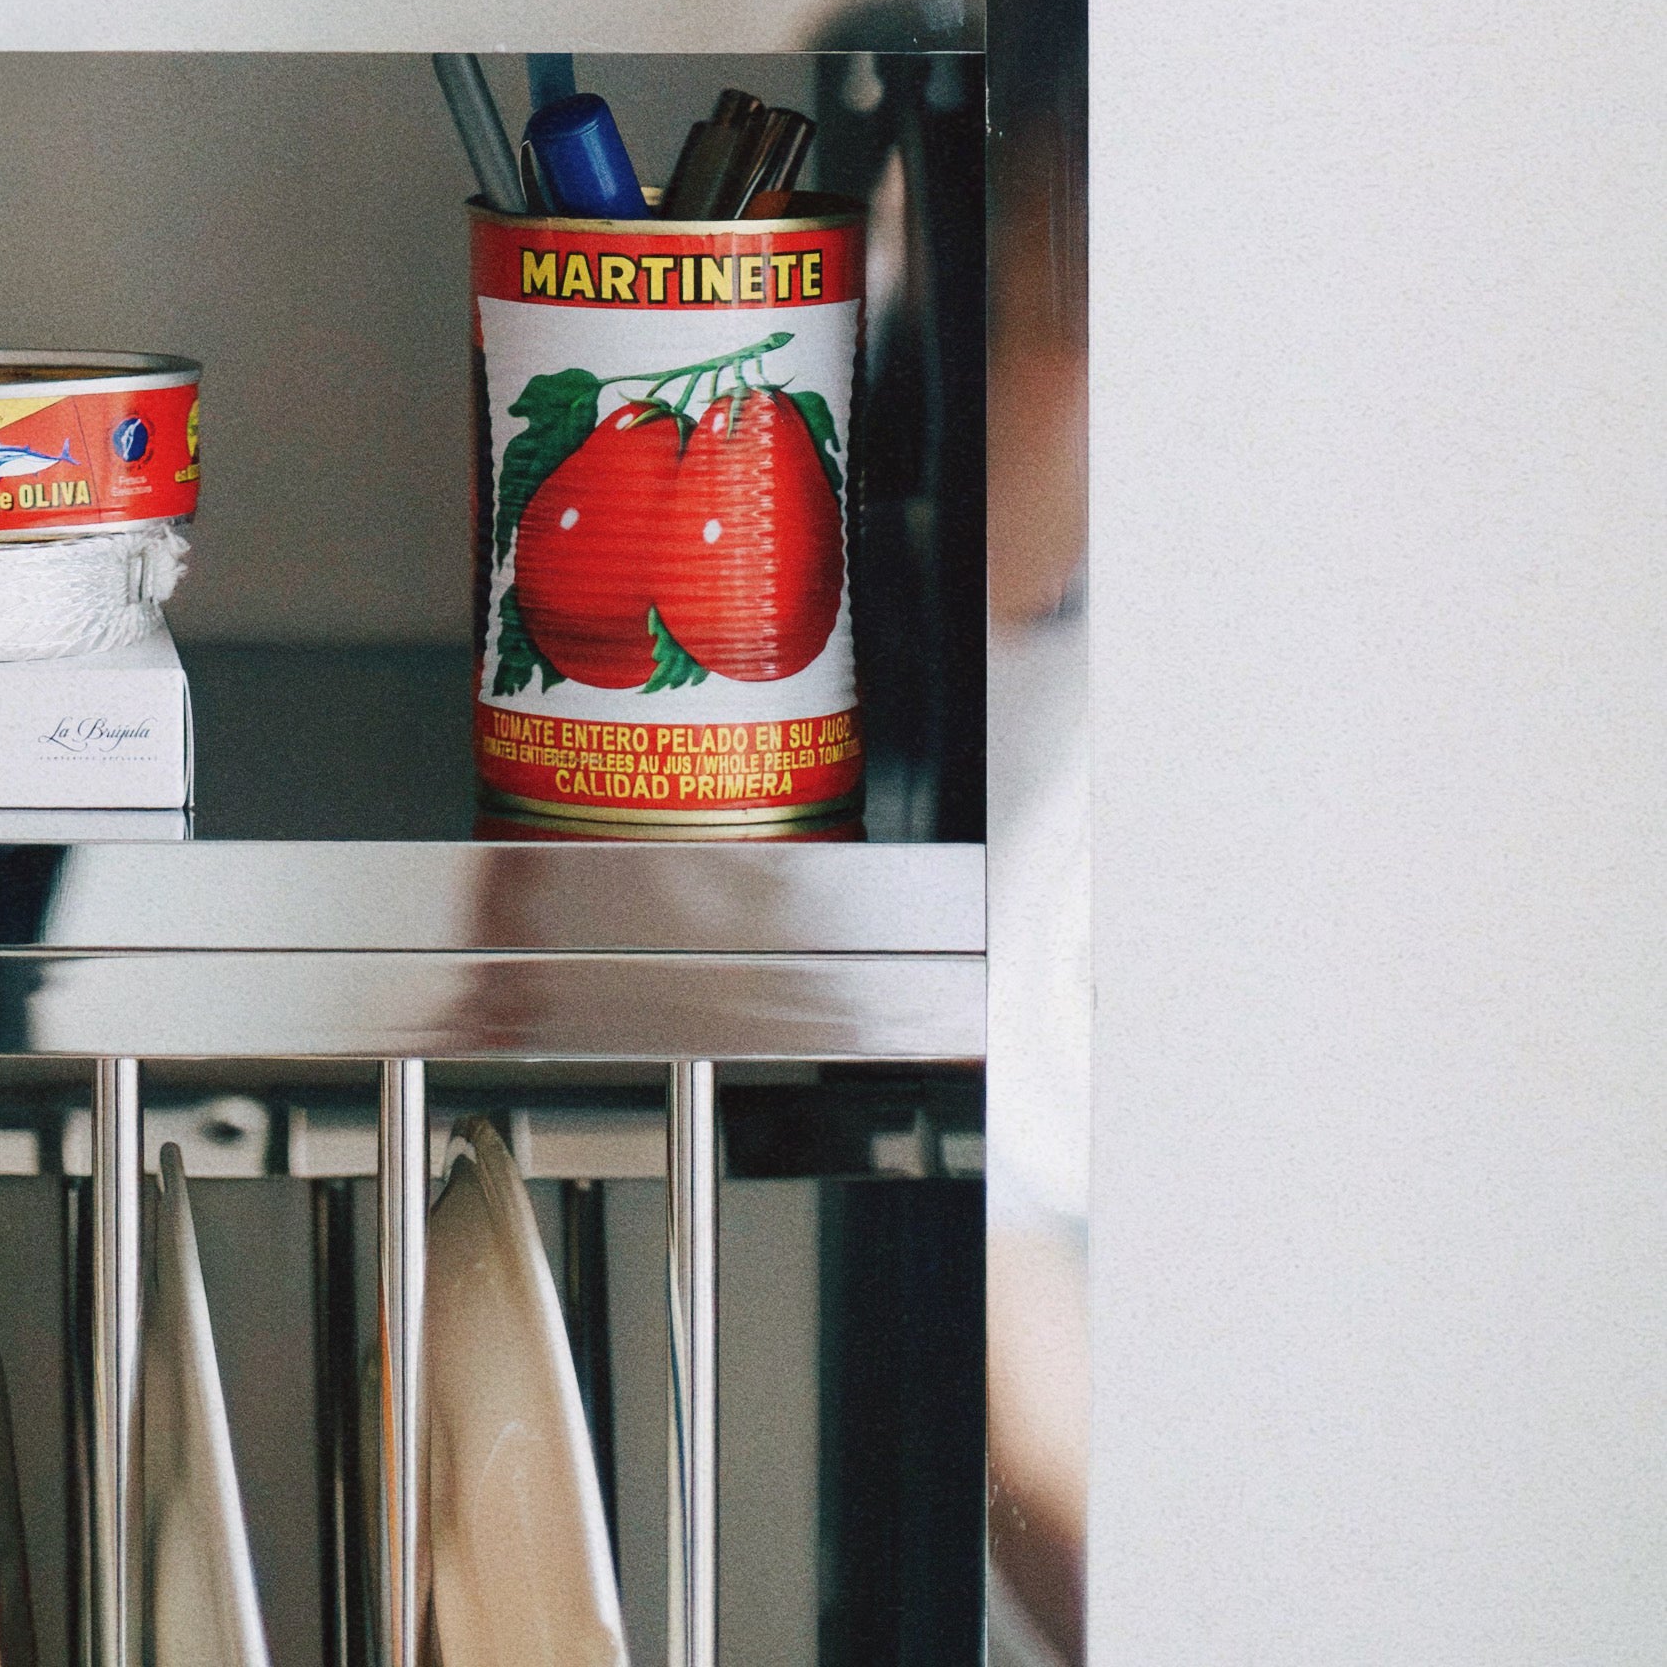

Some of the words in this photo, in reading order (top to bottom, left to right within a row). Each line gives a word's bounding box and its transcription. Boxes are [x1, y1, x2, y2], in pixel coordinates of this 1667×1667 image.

[520, 246, 823, 305] MARTINETE
[19, 479, 91, 510] OLIVA
[492, 711, 555, 746] TOMATE
[561, 722, 649, 753] ENTERO
[656, 726, 749, 754] PELADO
[755, 724, 783, 752] EN
[789, 722, 814, 749] SU
[637, 754, 660, 775] AU
[662, 754, 692, 775] JUS
[703, 753, 760, 775] WHOLE
[763, 748, 815, 772] PEELED
[554, 768, 671, 800] CALIDAD
[679, 771, 793, 800] PRIMERA
